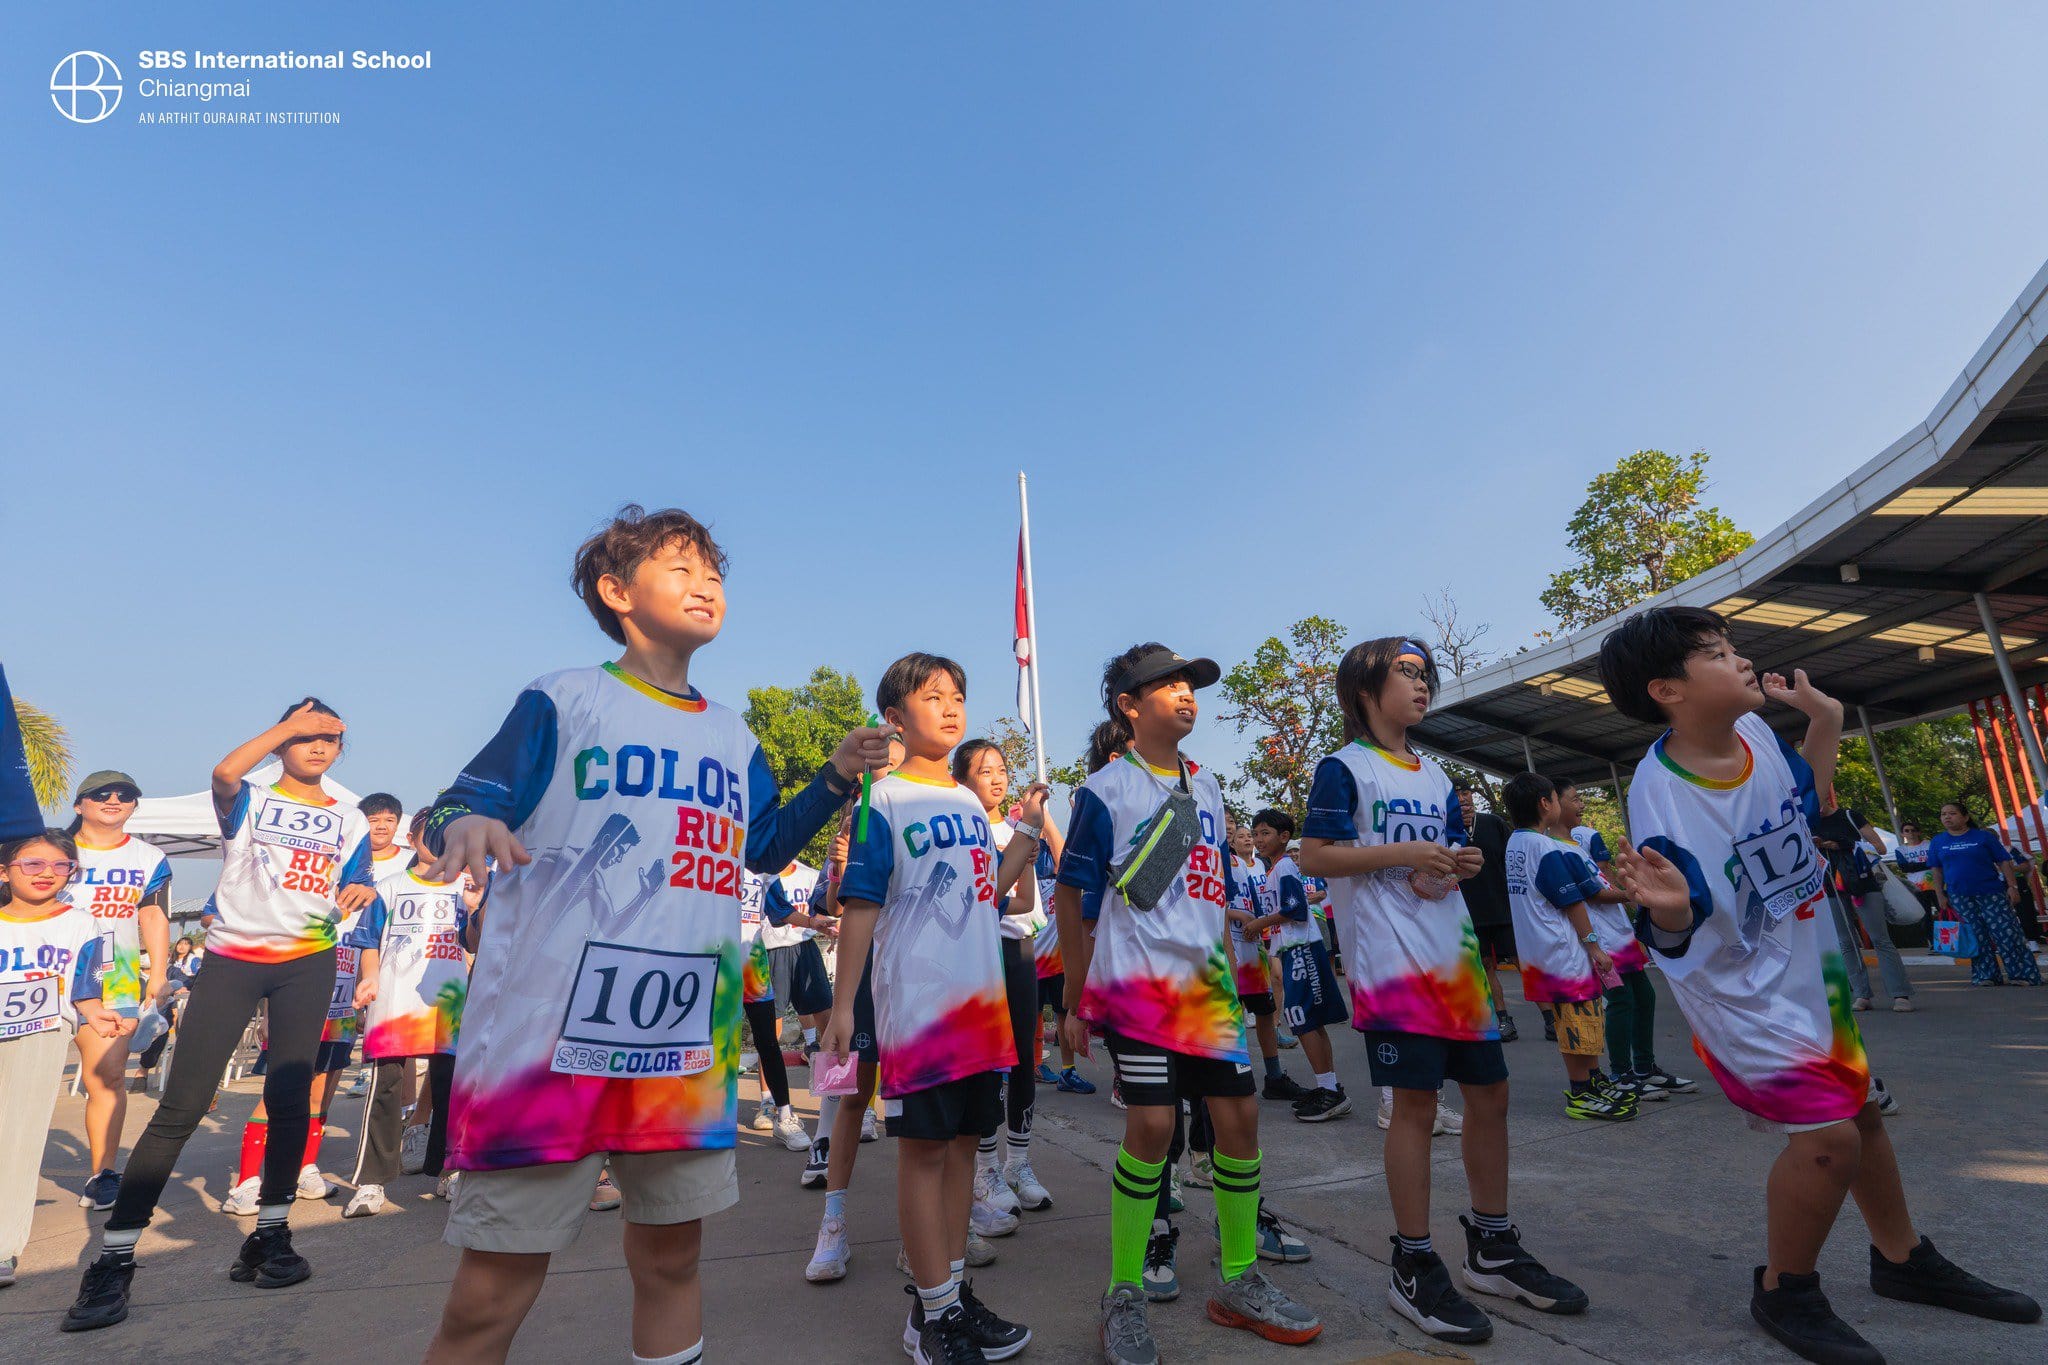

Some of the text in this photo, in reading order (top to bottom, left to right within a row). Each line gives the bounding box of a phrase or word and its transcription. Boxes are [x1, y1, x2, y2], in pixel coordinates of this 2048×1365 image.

[265, 807, 333, 835] 139
[1393, 822, 1445, 843] 08
[279, 836, 321, 851] COLOR
[902, 813, 992, 859] COLO
[1749, 832, 1812, 886] 12
[424, 944, 463, 962] 2026
[580, 966, 700, 1031] 109
[1284, 1005, 1306, 1028] 10
[555, 1046, 682, 1074] SBS COLOR
[683, 1059, 711, 1071] 2026
[684, 1049, 711, 1061] RUN
